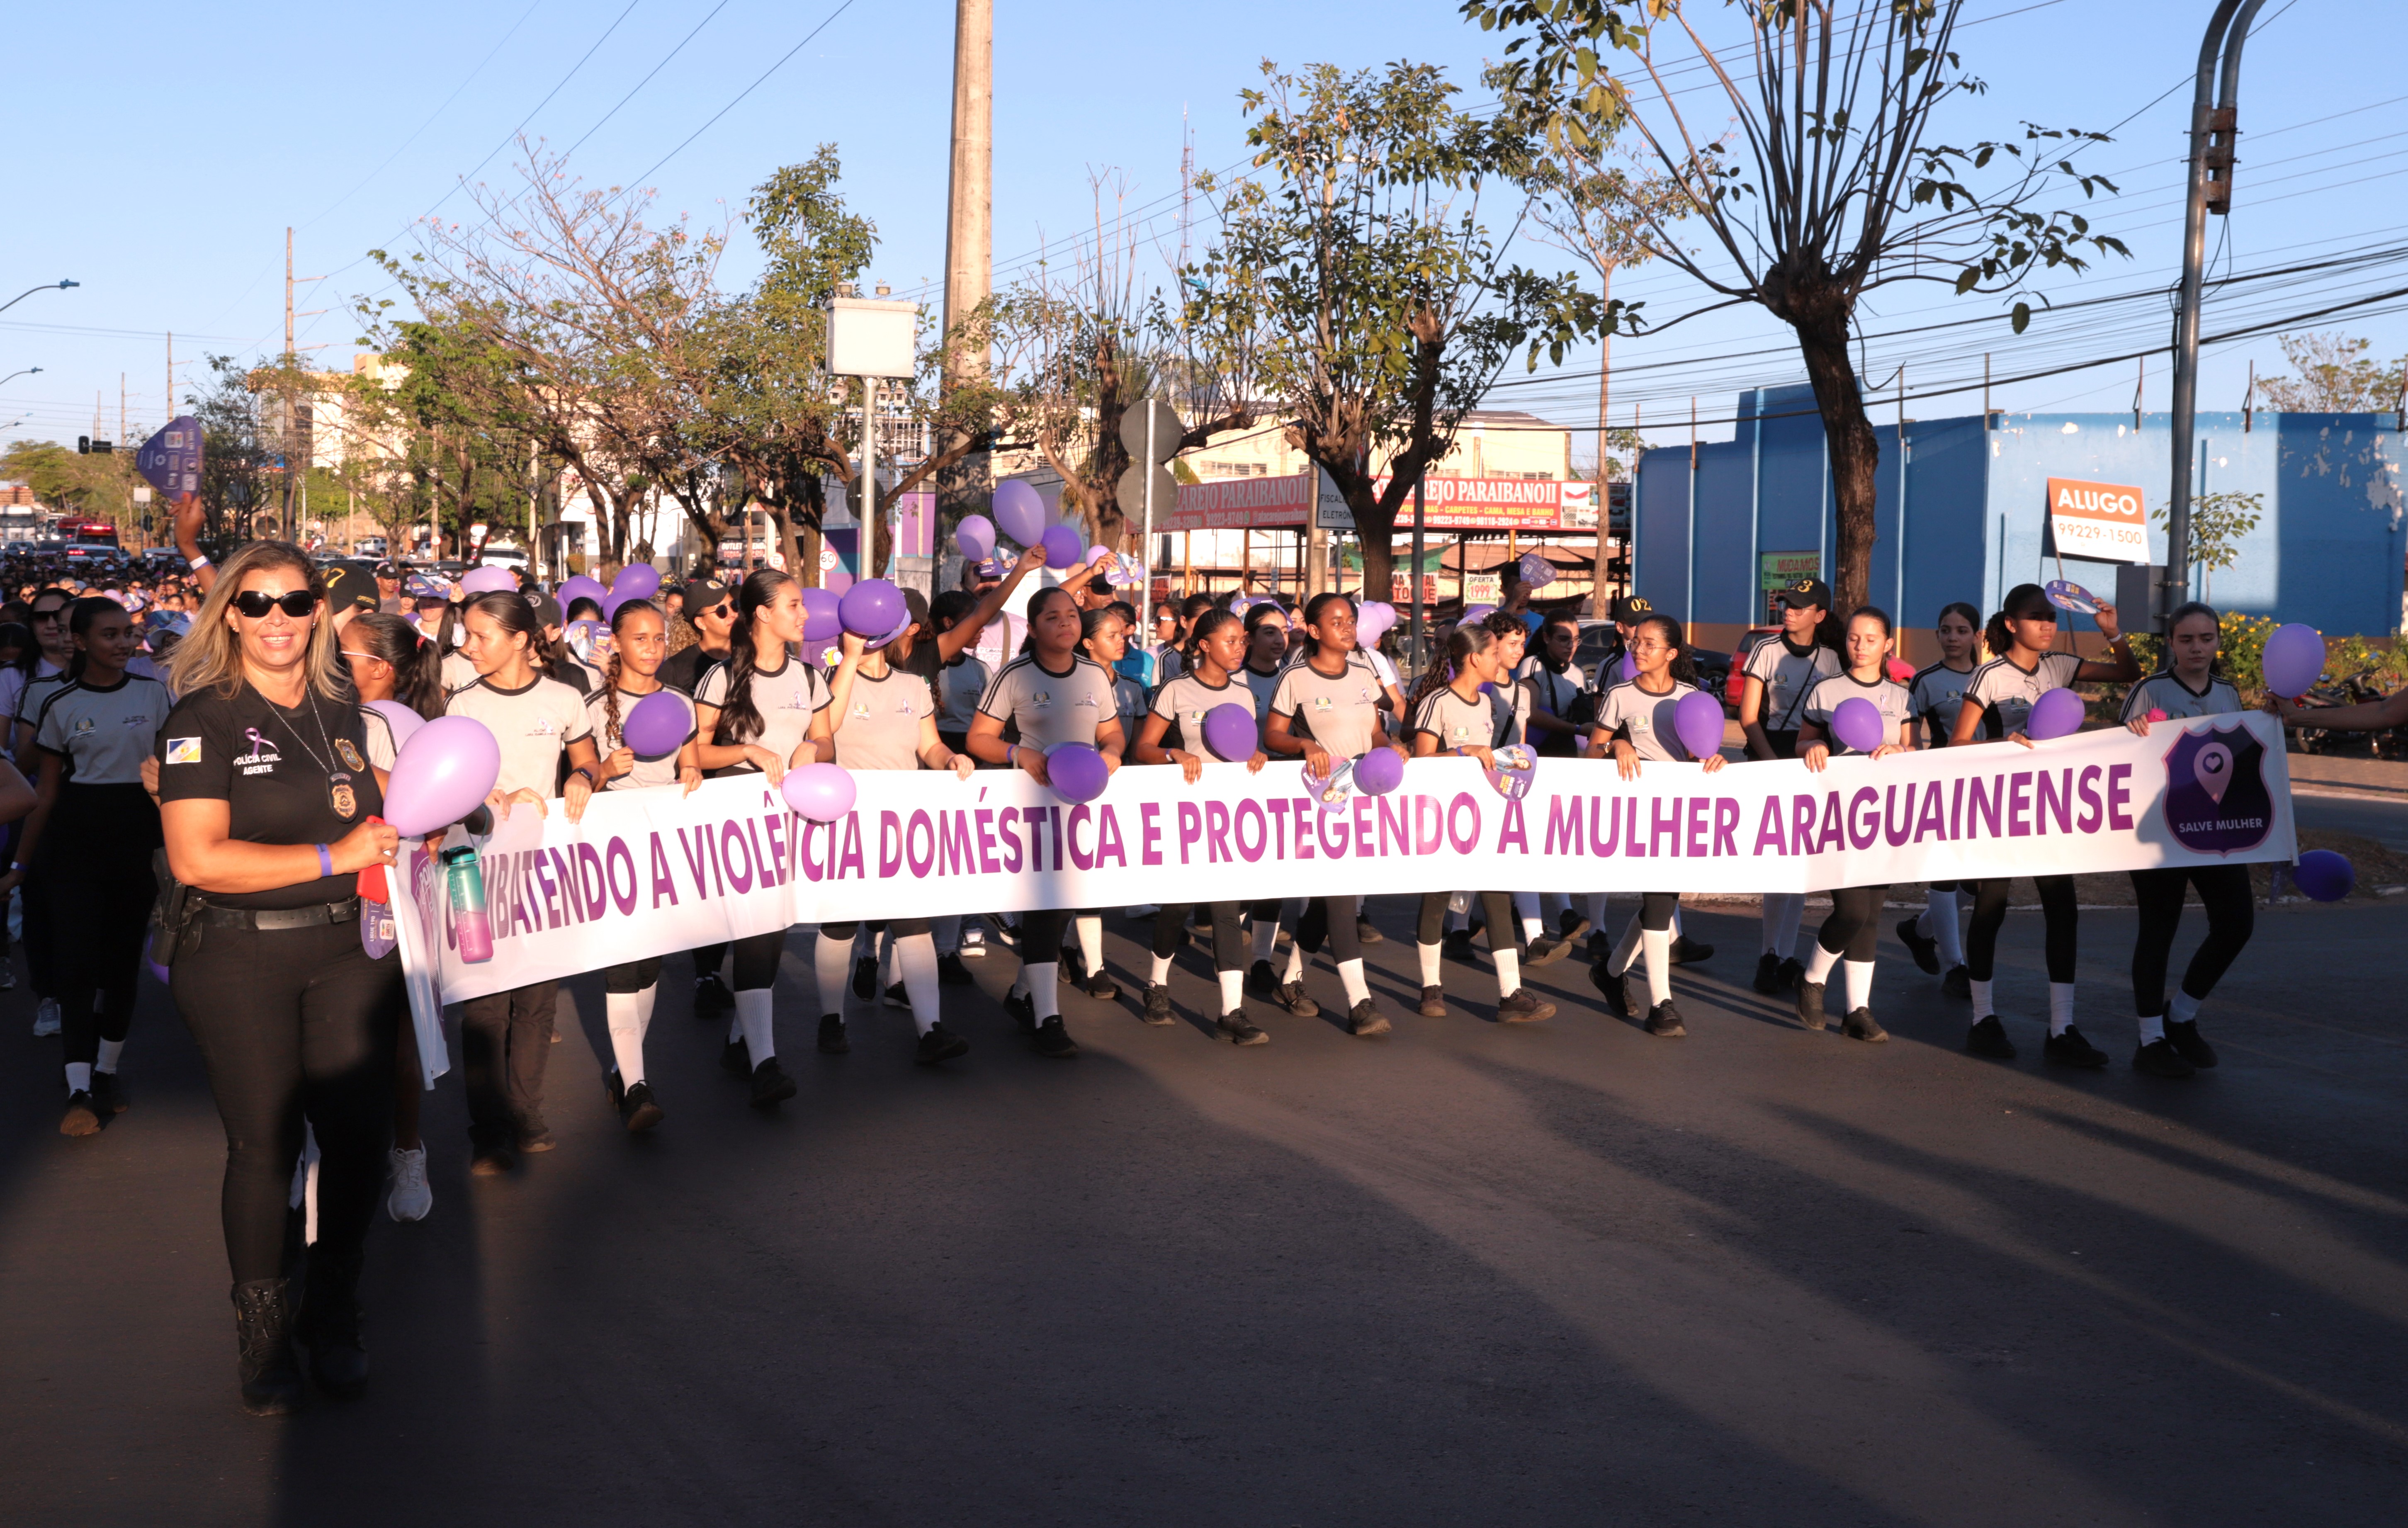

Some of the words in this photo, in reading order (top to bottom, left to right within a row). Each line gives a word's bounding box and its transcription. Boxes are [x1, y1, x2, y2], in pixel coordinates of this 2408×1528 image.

[2058, 488, 2137, 515] ALUGO
[1445, 506, 1478, 514] CARPETES
[1484, 507, 1505, 516] CAMA,
[1206, 510, 1244, 527] 99223-9749
[1433, 515, 1470, 525] 99223-9749
[1476, 516, 1513, 526] 98118-2924
[2058, 522, 2142, 544] 99229-1500
[821, 554, 834, 563] 60
[1777, 557, 1820, 572] MUDAMOS
[1631, 598, 1652, 612] 02
[233, 754, 260, 766] POLÍCIA
[261, 753, 282, 763] CIVIL
[243, 764, 273, 775] AGENTE
[2179, 821, 2213, 833] SALVE
[2216, 817, 2263, 831] MULHER
[650, 831, 679, 909] A
[879, 786, 1127, 878] DOMÉSTICA
[1140, 802, 1162, 865] E
[1178, 792, 1482, 864] PROTEGENDO
[1497, 800, 1529, 854] A
[1544, 794, 1740, 858] MULHER
[1753, 763, 2134, 856] ARAGUAINENSE
